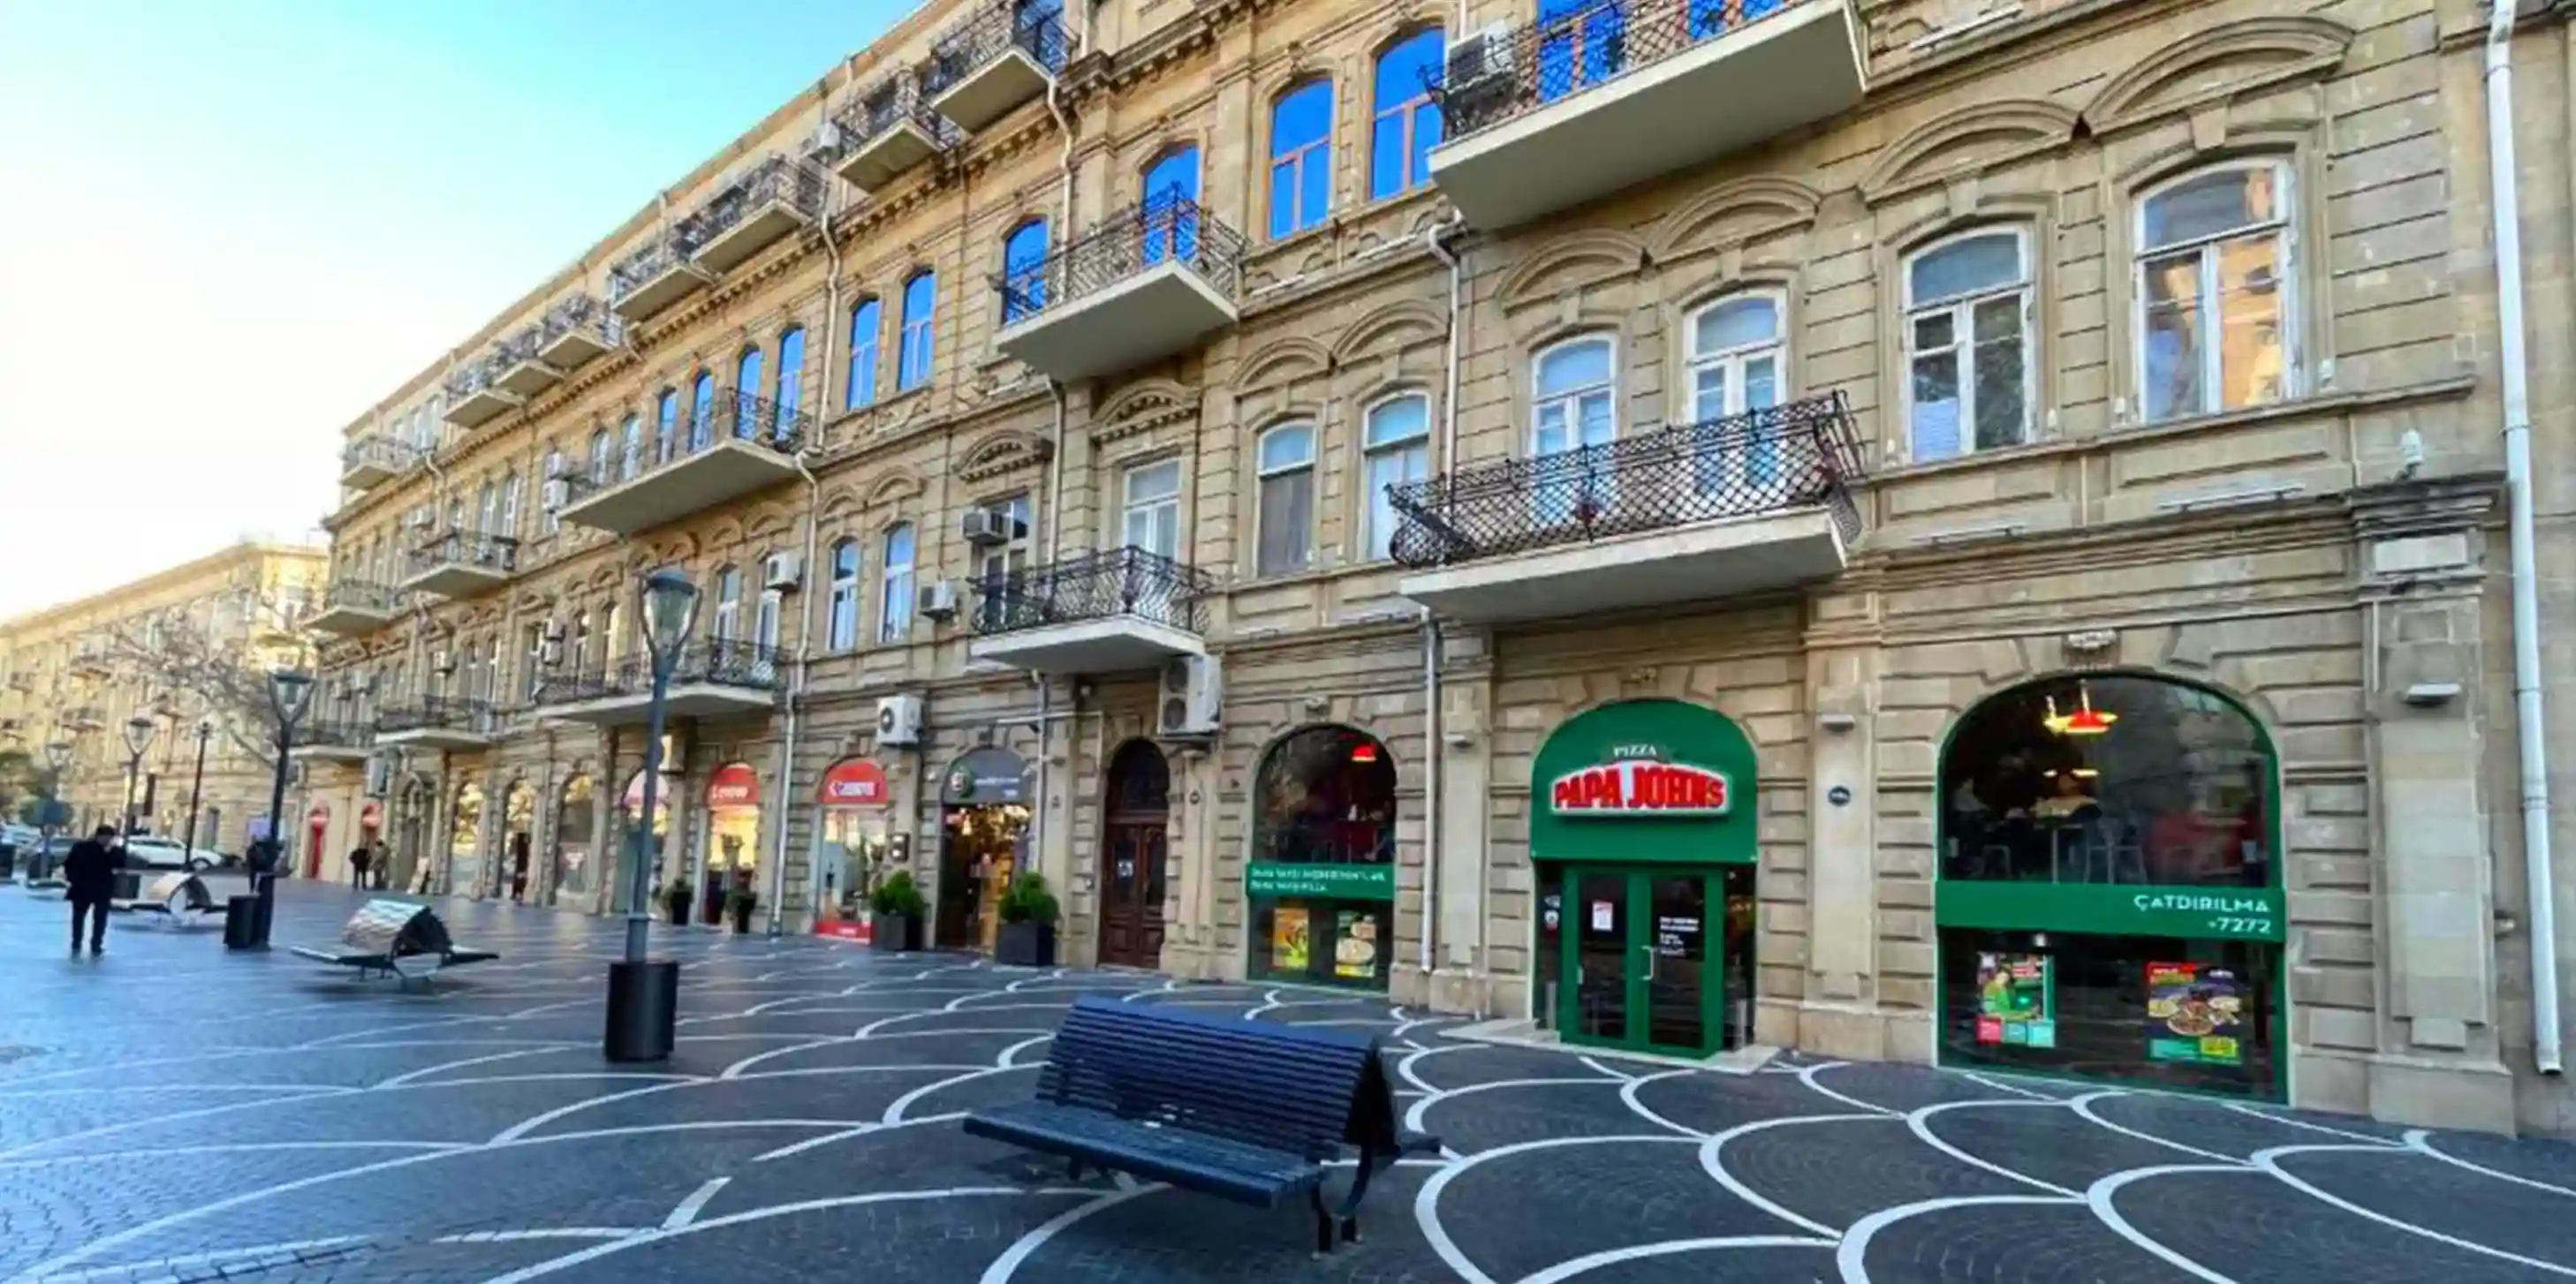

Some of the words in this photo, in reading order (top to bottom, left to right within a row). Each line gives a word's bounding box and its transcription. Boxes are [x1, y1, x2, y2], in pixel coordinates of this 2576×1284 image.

[1613, 744, 1657, 757] PIZZA
[1555, 767, 1622, 808] PAPA
[2133, 895, 2270, 912] ÇATDIRILMA
